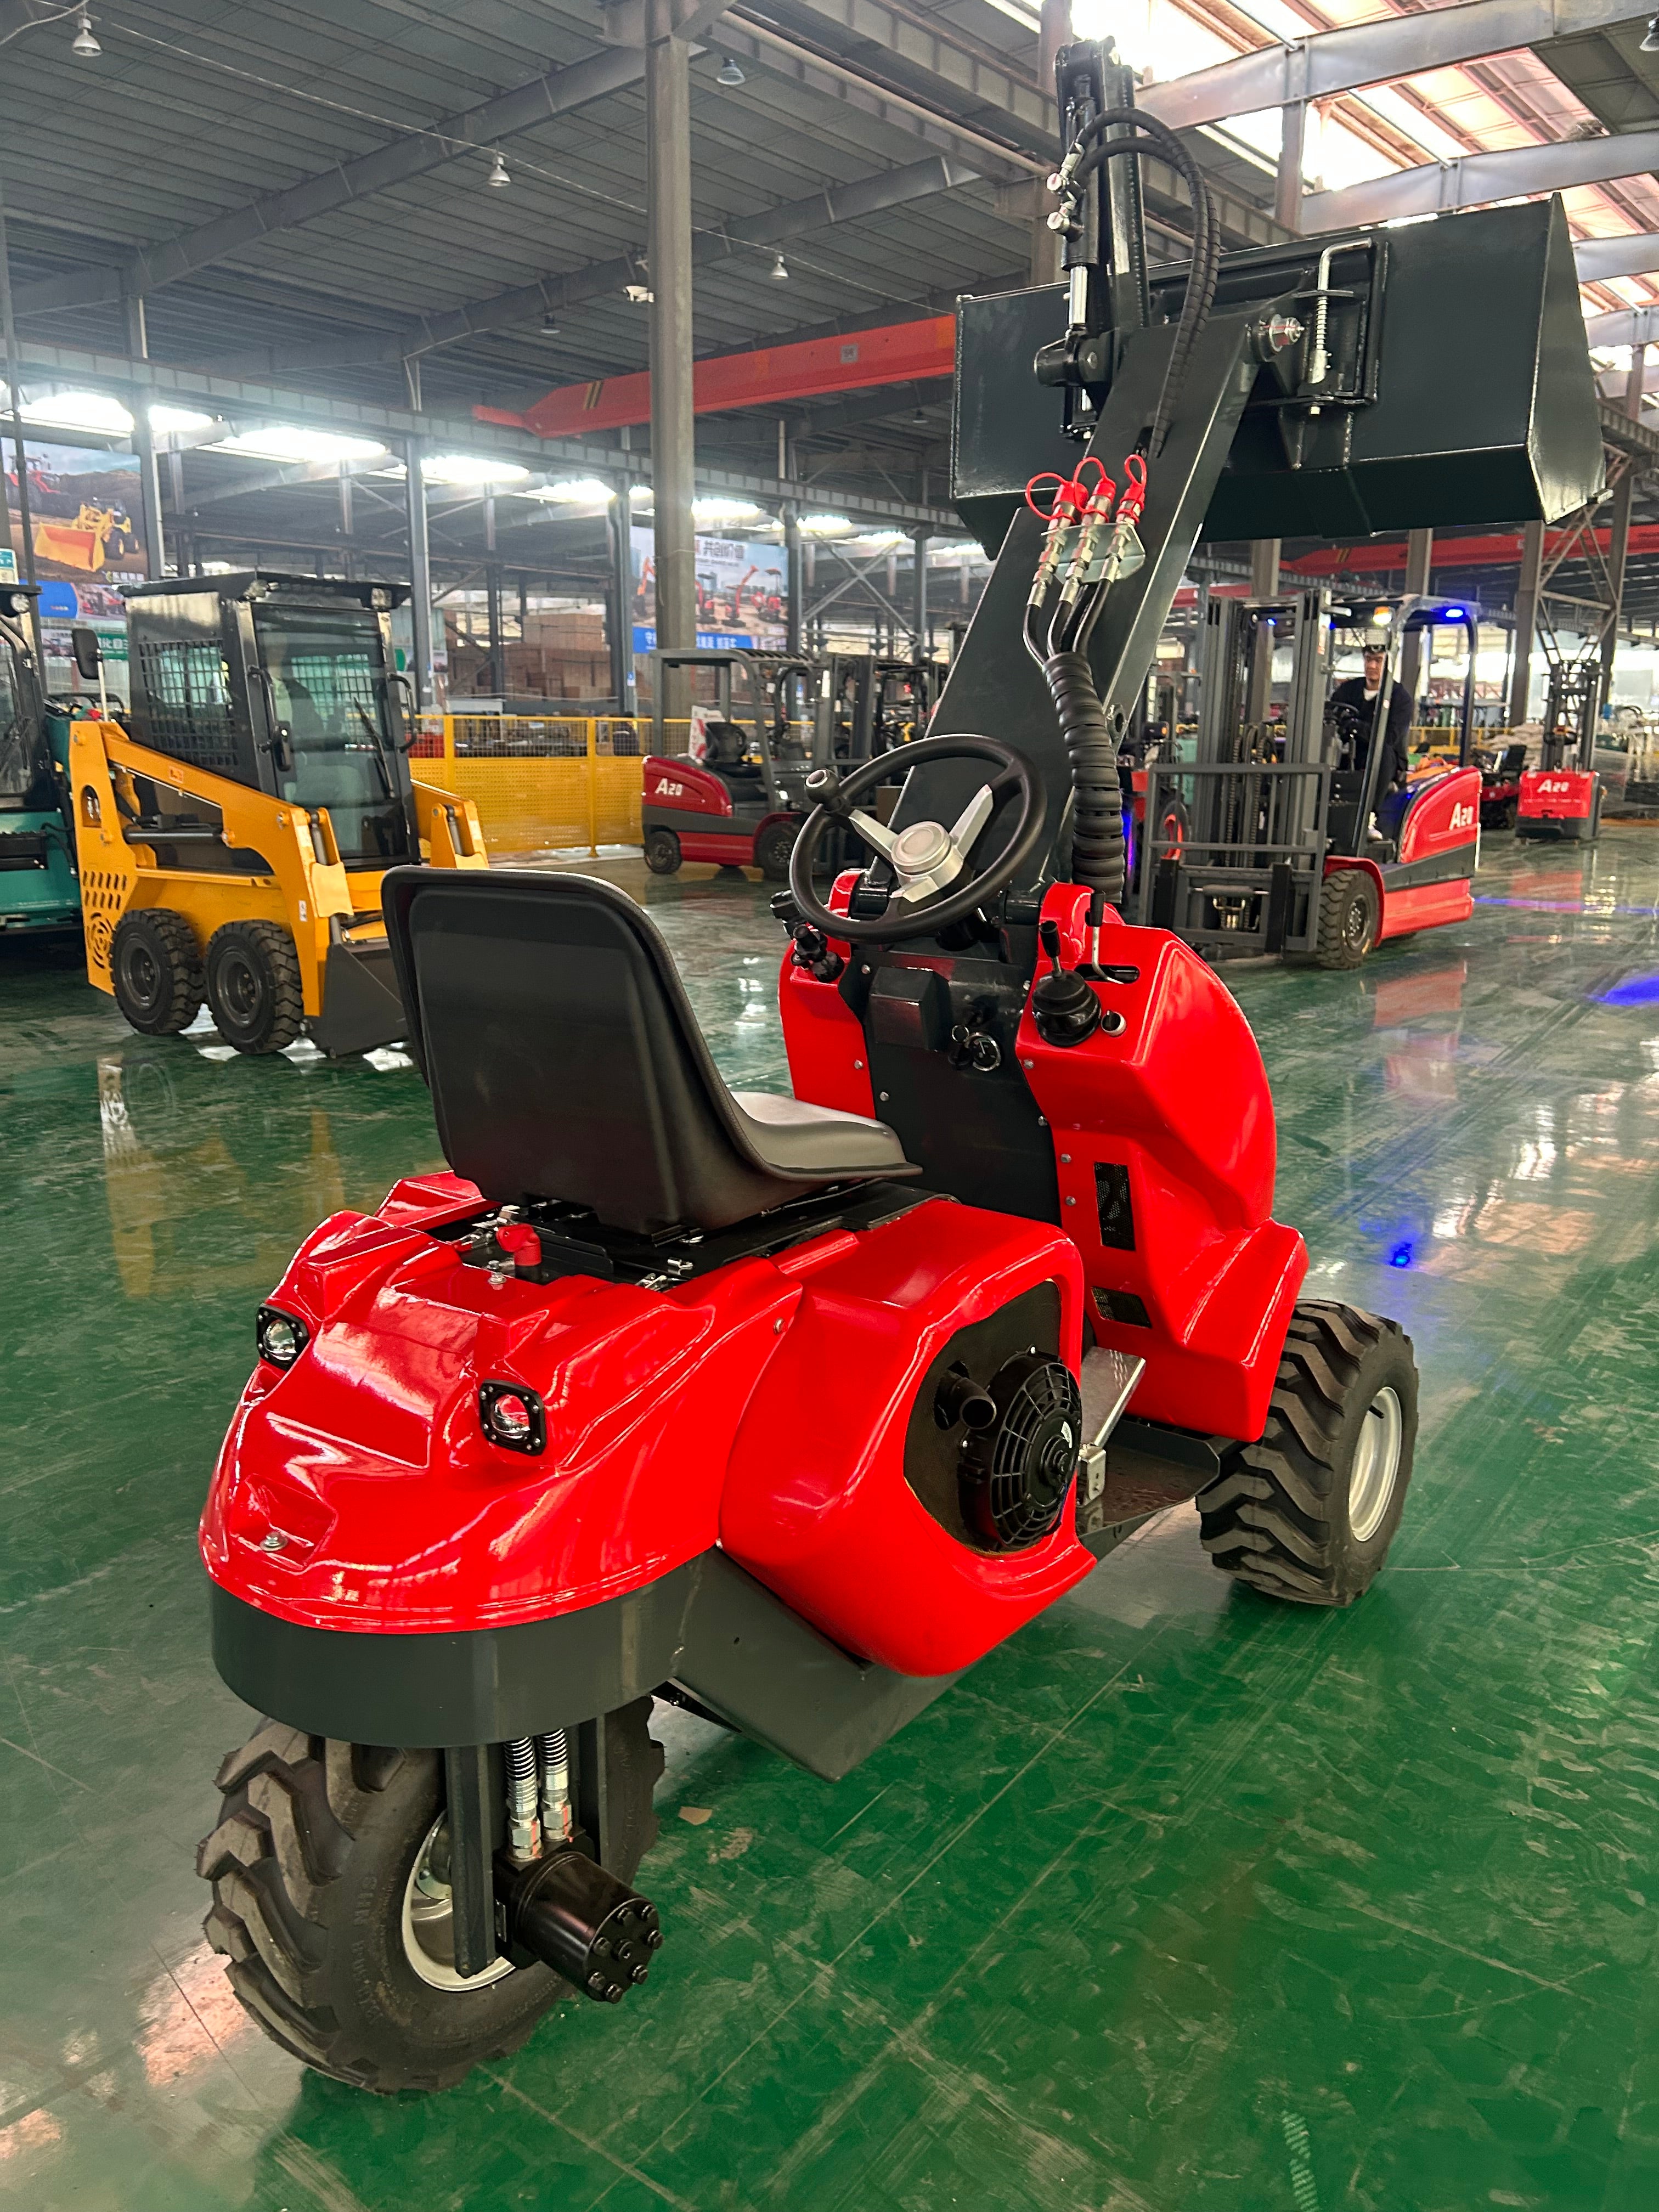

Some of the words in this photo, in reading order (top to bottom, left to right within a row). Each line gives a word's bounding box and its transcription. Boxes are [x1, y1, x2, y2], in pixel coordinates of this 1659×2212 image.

[654, 777, 683, 797] A20
[1537, 778, 1570, 793] A20
[1448, 802, 1474, 831] A20
